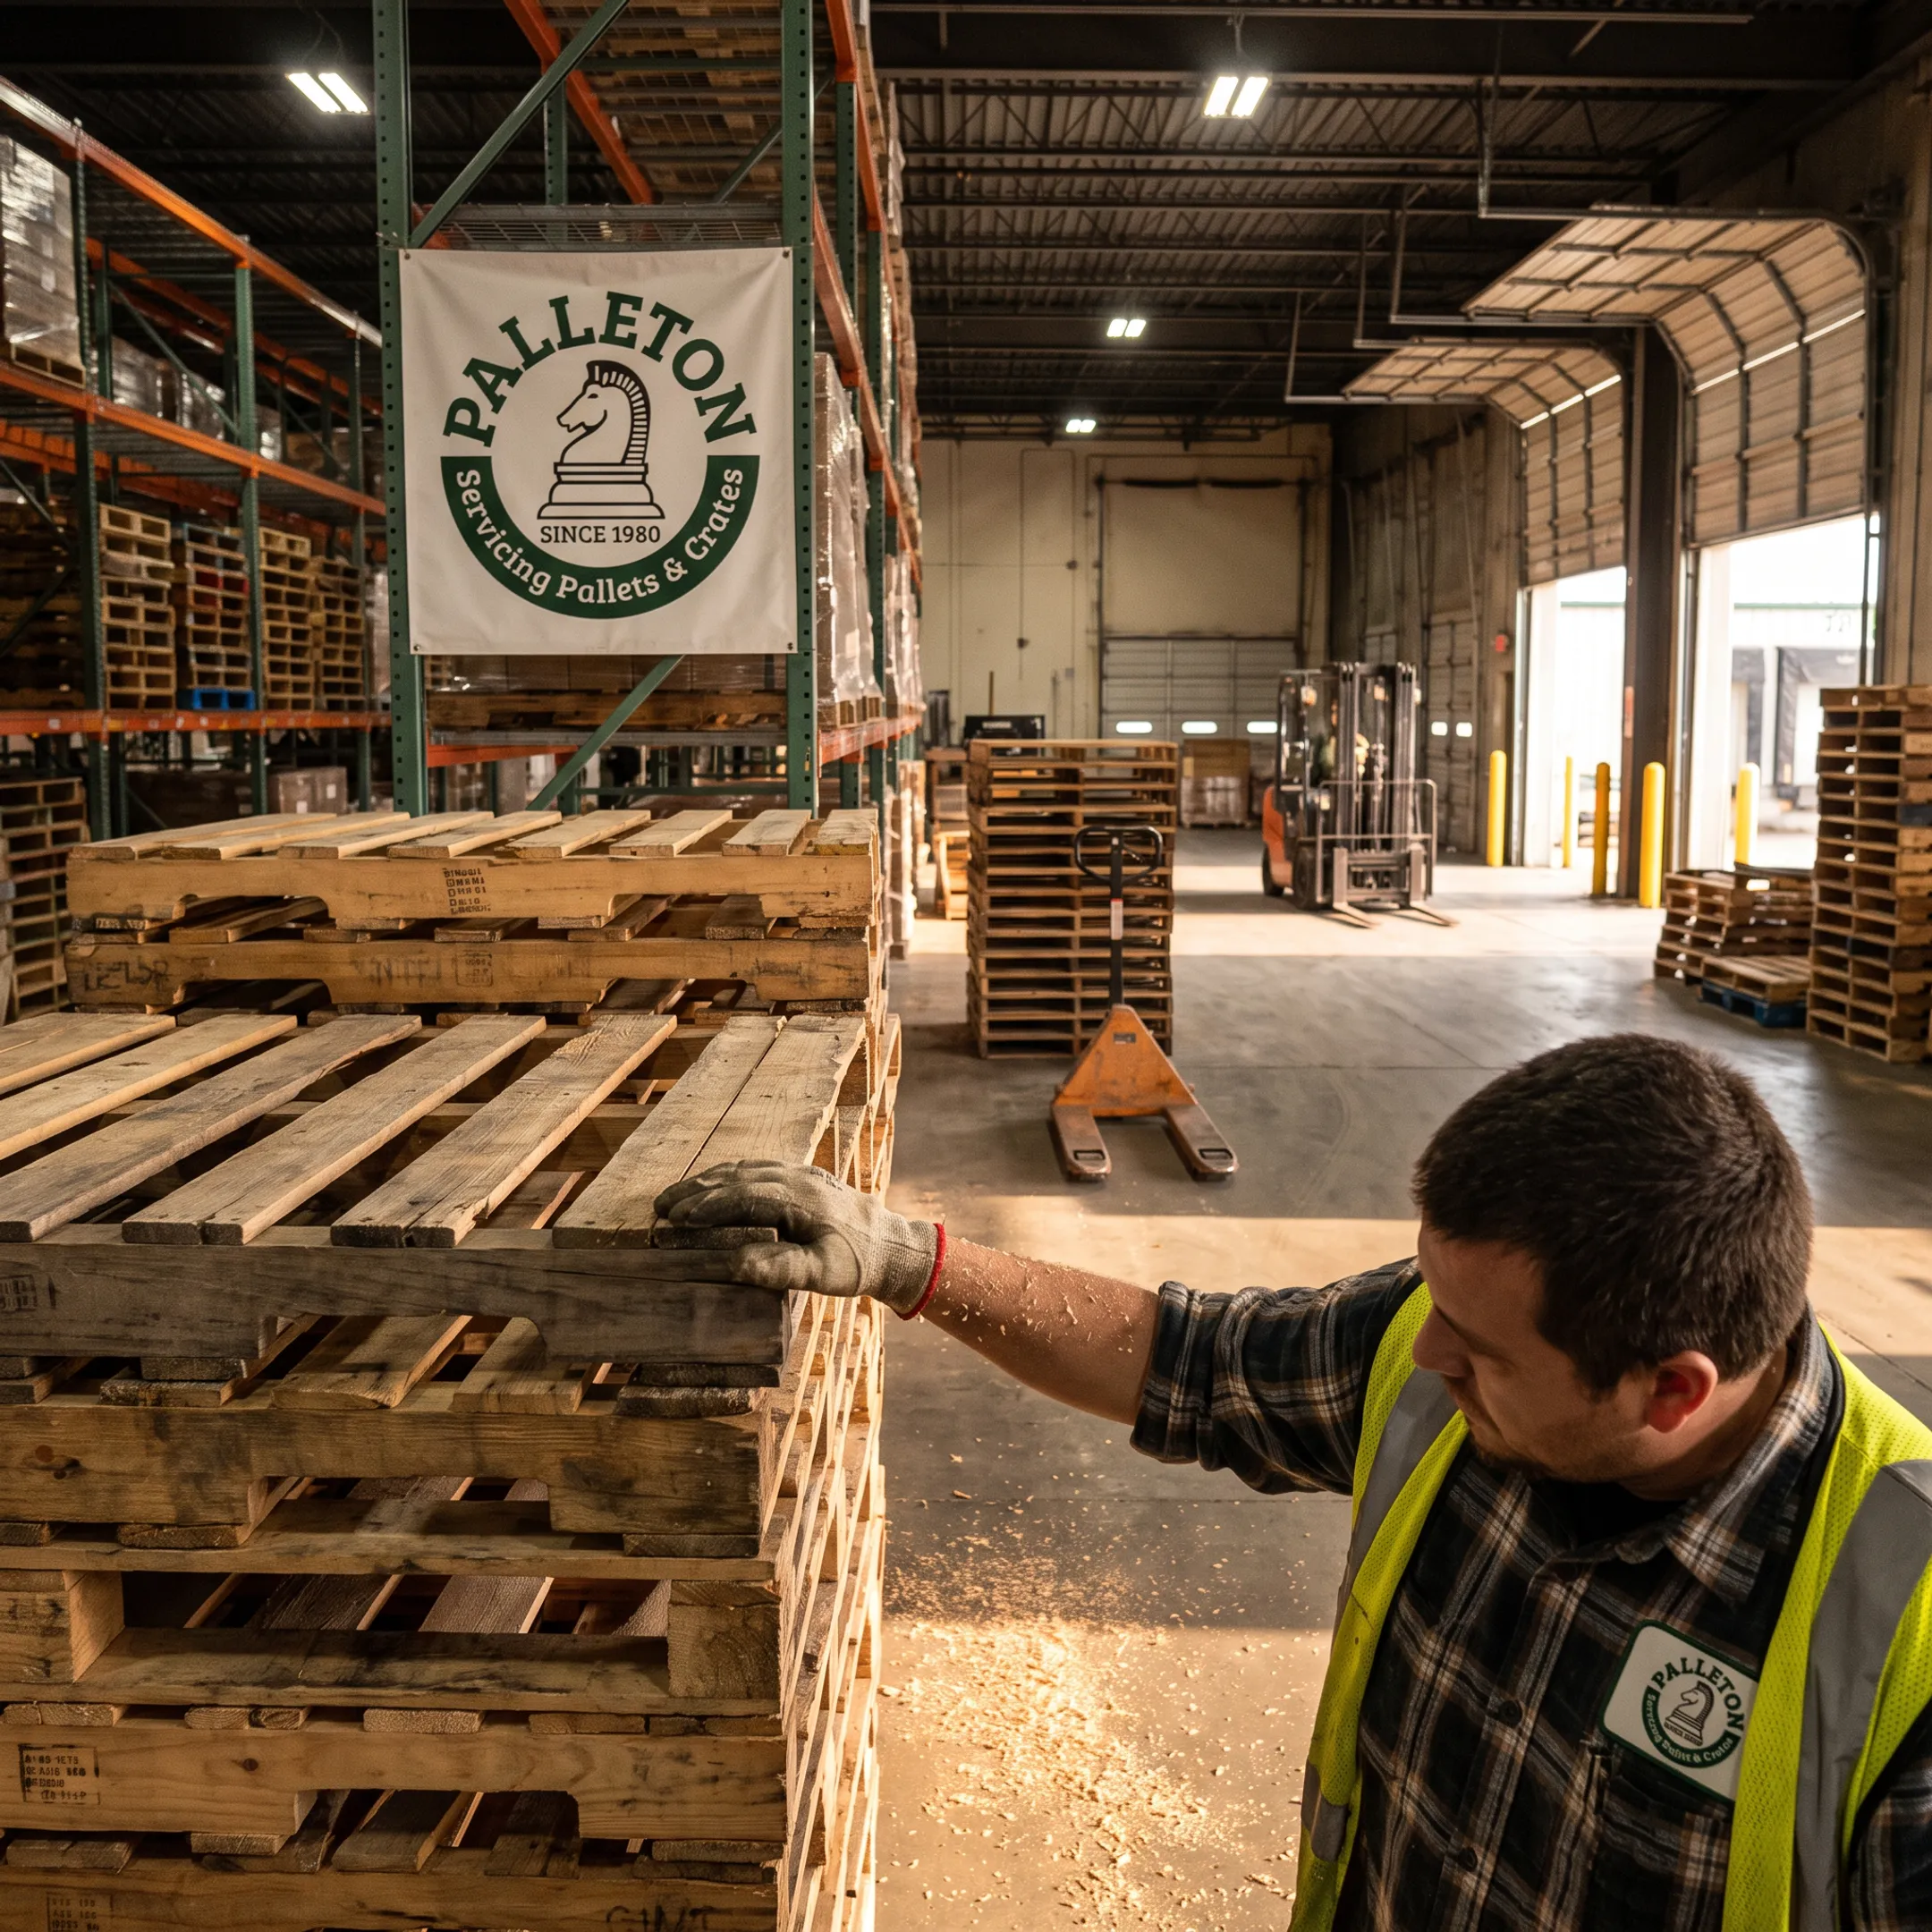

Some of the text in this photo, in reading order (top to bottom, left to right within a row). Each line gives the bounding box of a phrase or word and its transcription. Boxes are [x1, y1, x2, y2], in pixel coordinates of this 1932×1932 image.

[442, 291, 758, 448] PALLETON
[455, 468, 744, 605] Servicing Pallets & Crates
[539, 525, 662, 544] SINCE 1980
[1650, 1657, 1745, 1732] PALLETON
